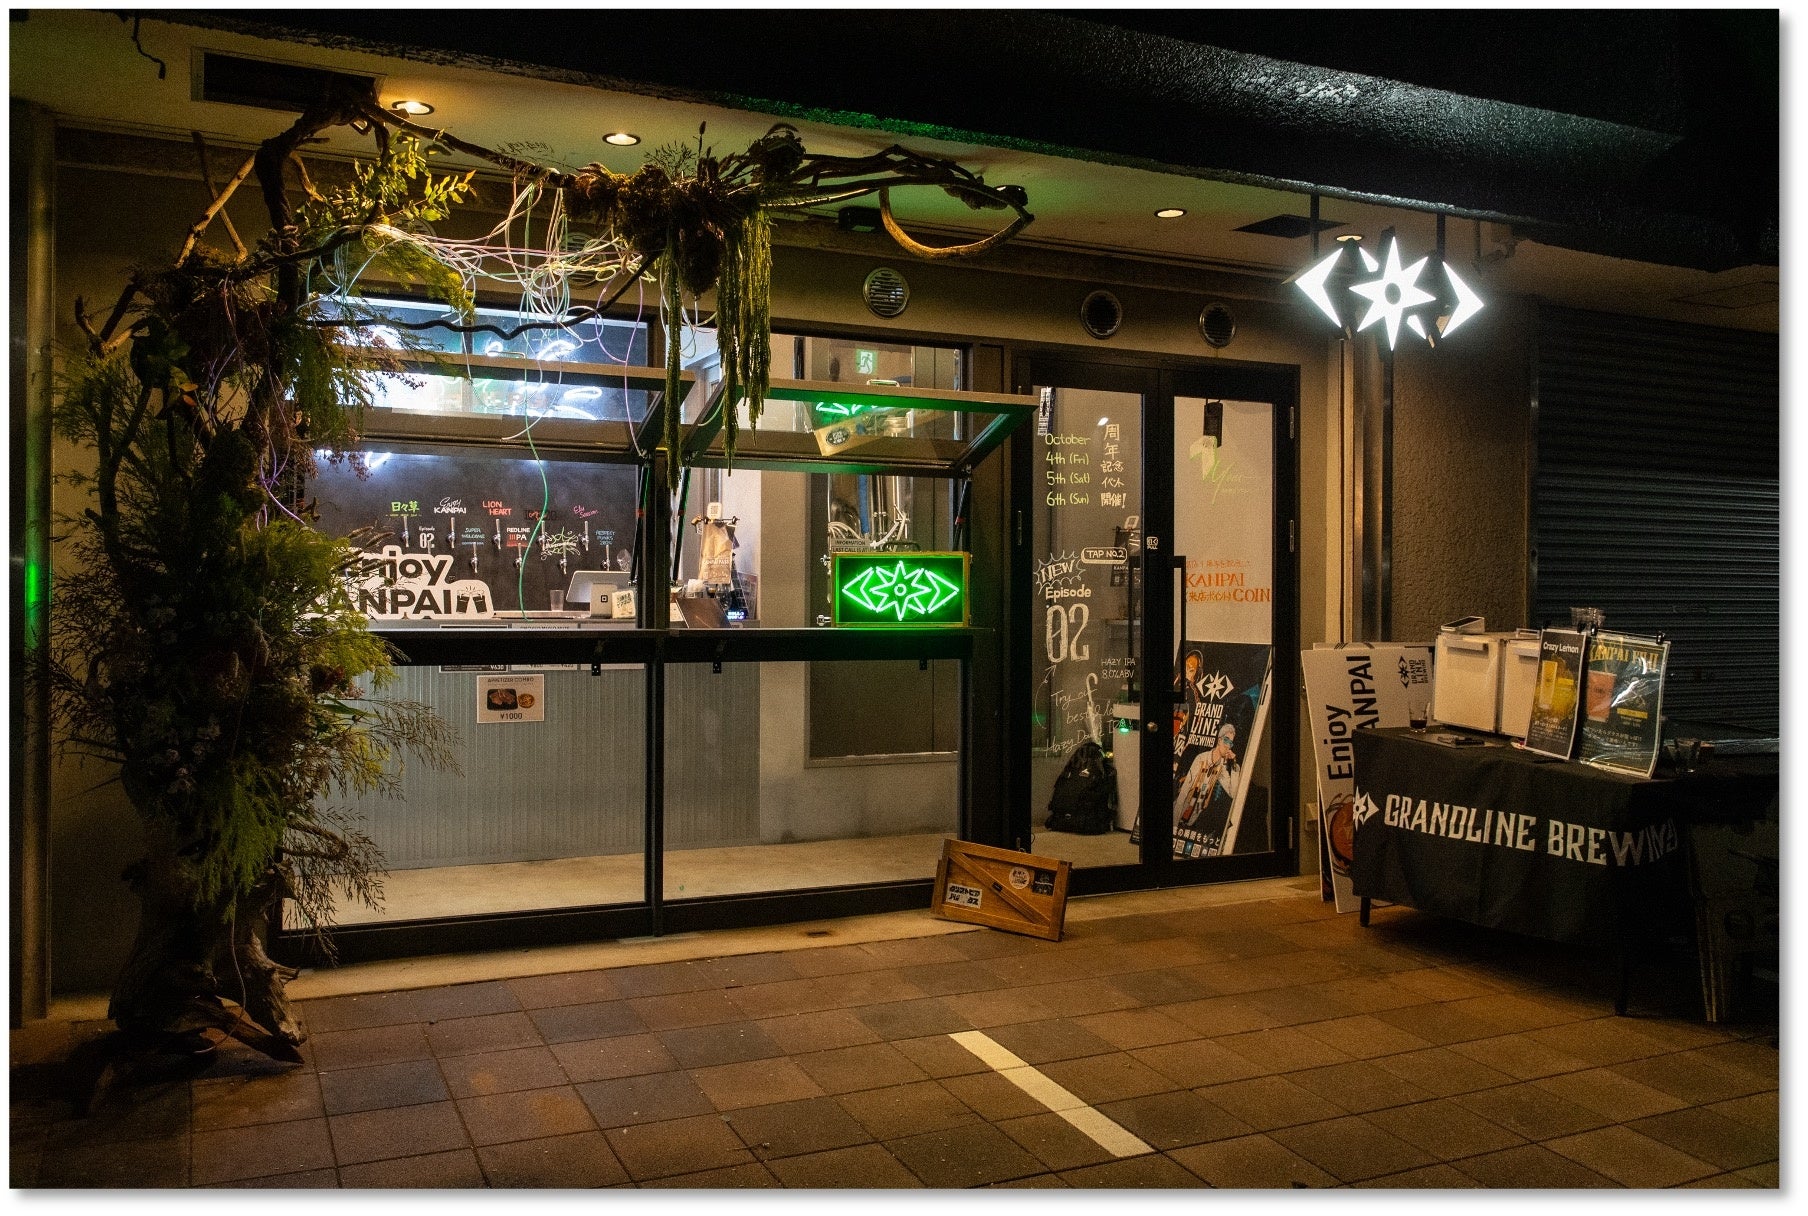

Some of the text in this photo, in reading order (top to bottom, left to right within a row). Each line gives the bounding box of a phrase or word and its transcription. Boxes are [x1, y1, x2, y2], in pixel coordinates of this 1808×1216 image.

[1045, 433, 1091, 445] October
[1046, 452, 1089, 465] 4th (Fri)
[1046, 471, 1090, 485] 5th (Sat)
[482, 500, 503, 508] LION
[1046, 491, 1089, 506] 6th (Sun)
[489, 508, 513, 516] HEART
[1086, 550, 1104, 558] TAP
[1040, 559, 1076, 583] NEW
[1045, 584, 1092, 602] Episode
[1232, 588, 1271, 602] COIN
[1046, 603, 1090, 663] 02
[1543, 641, 1579, 654] Crazy Lemon
[1124, 658, 1136, 666] IPA
[1050, 689, 1072, 710] Try
[1346, 655, 1379, 730] ANPAI
[500, 712, 523, 720] ¥1000
[1195, 702, 1224, 719] GRAND
[1190, 716, 1220, 737] LINE
[1384, 793, 1537, 852] GRANDLINE
